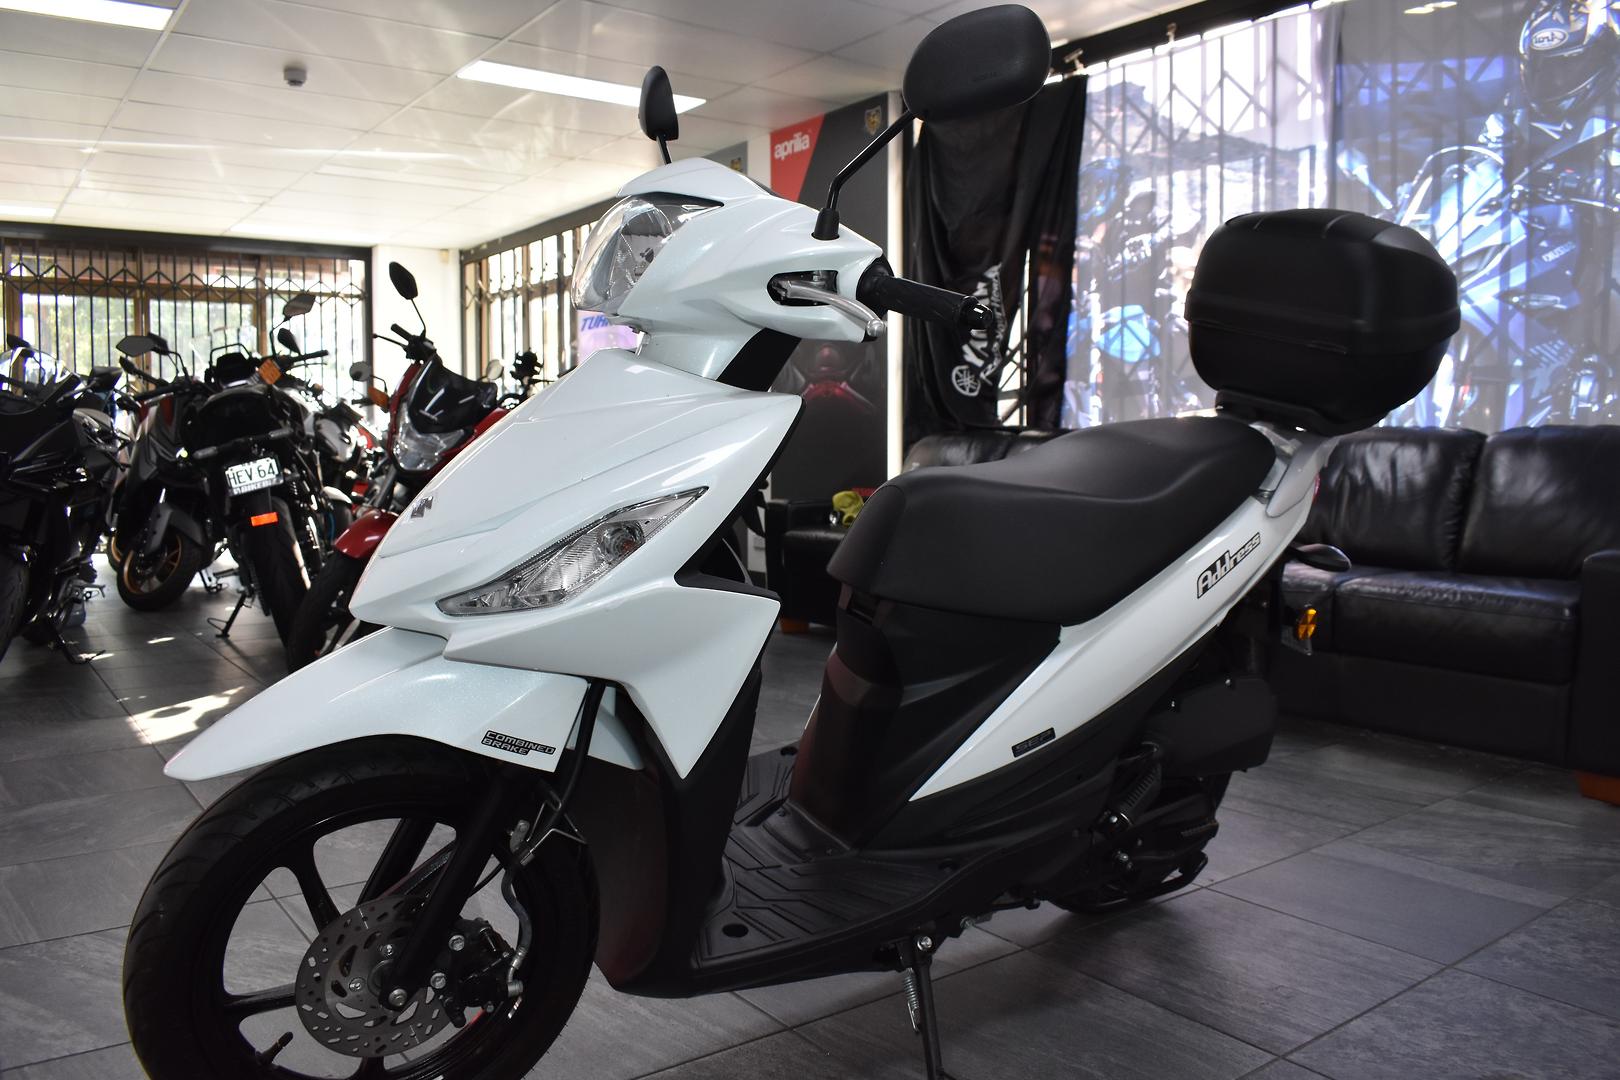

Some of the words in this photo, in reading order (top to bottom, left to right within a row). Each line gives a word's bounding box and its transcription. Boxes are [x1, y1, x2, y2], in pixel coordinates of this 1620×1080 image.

[774, 132, 810, 161] aprilia
[226, 467, 253, 487] HEV
[257, 462, 275, 478] 64
[1197, 532, 1260, 599] Address
[482, 738, 529, 755] BRAKE
[486, 731, 555, 754] COMBINED
